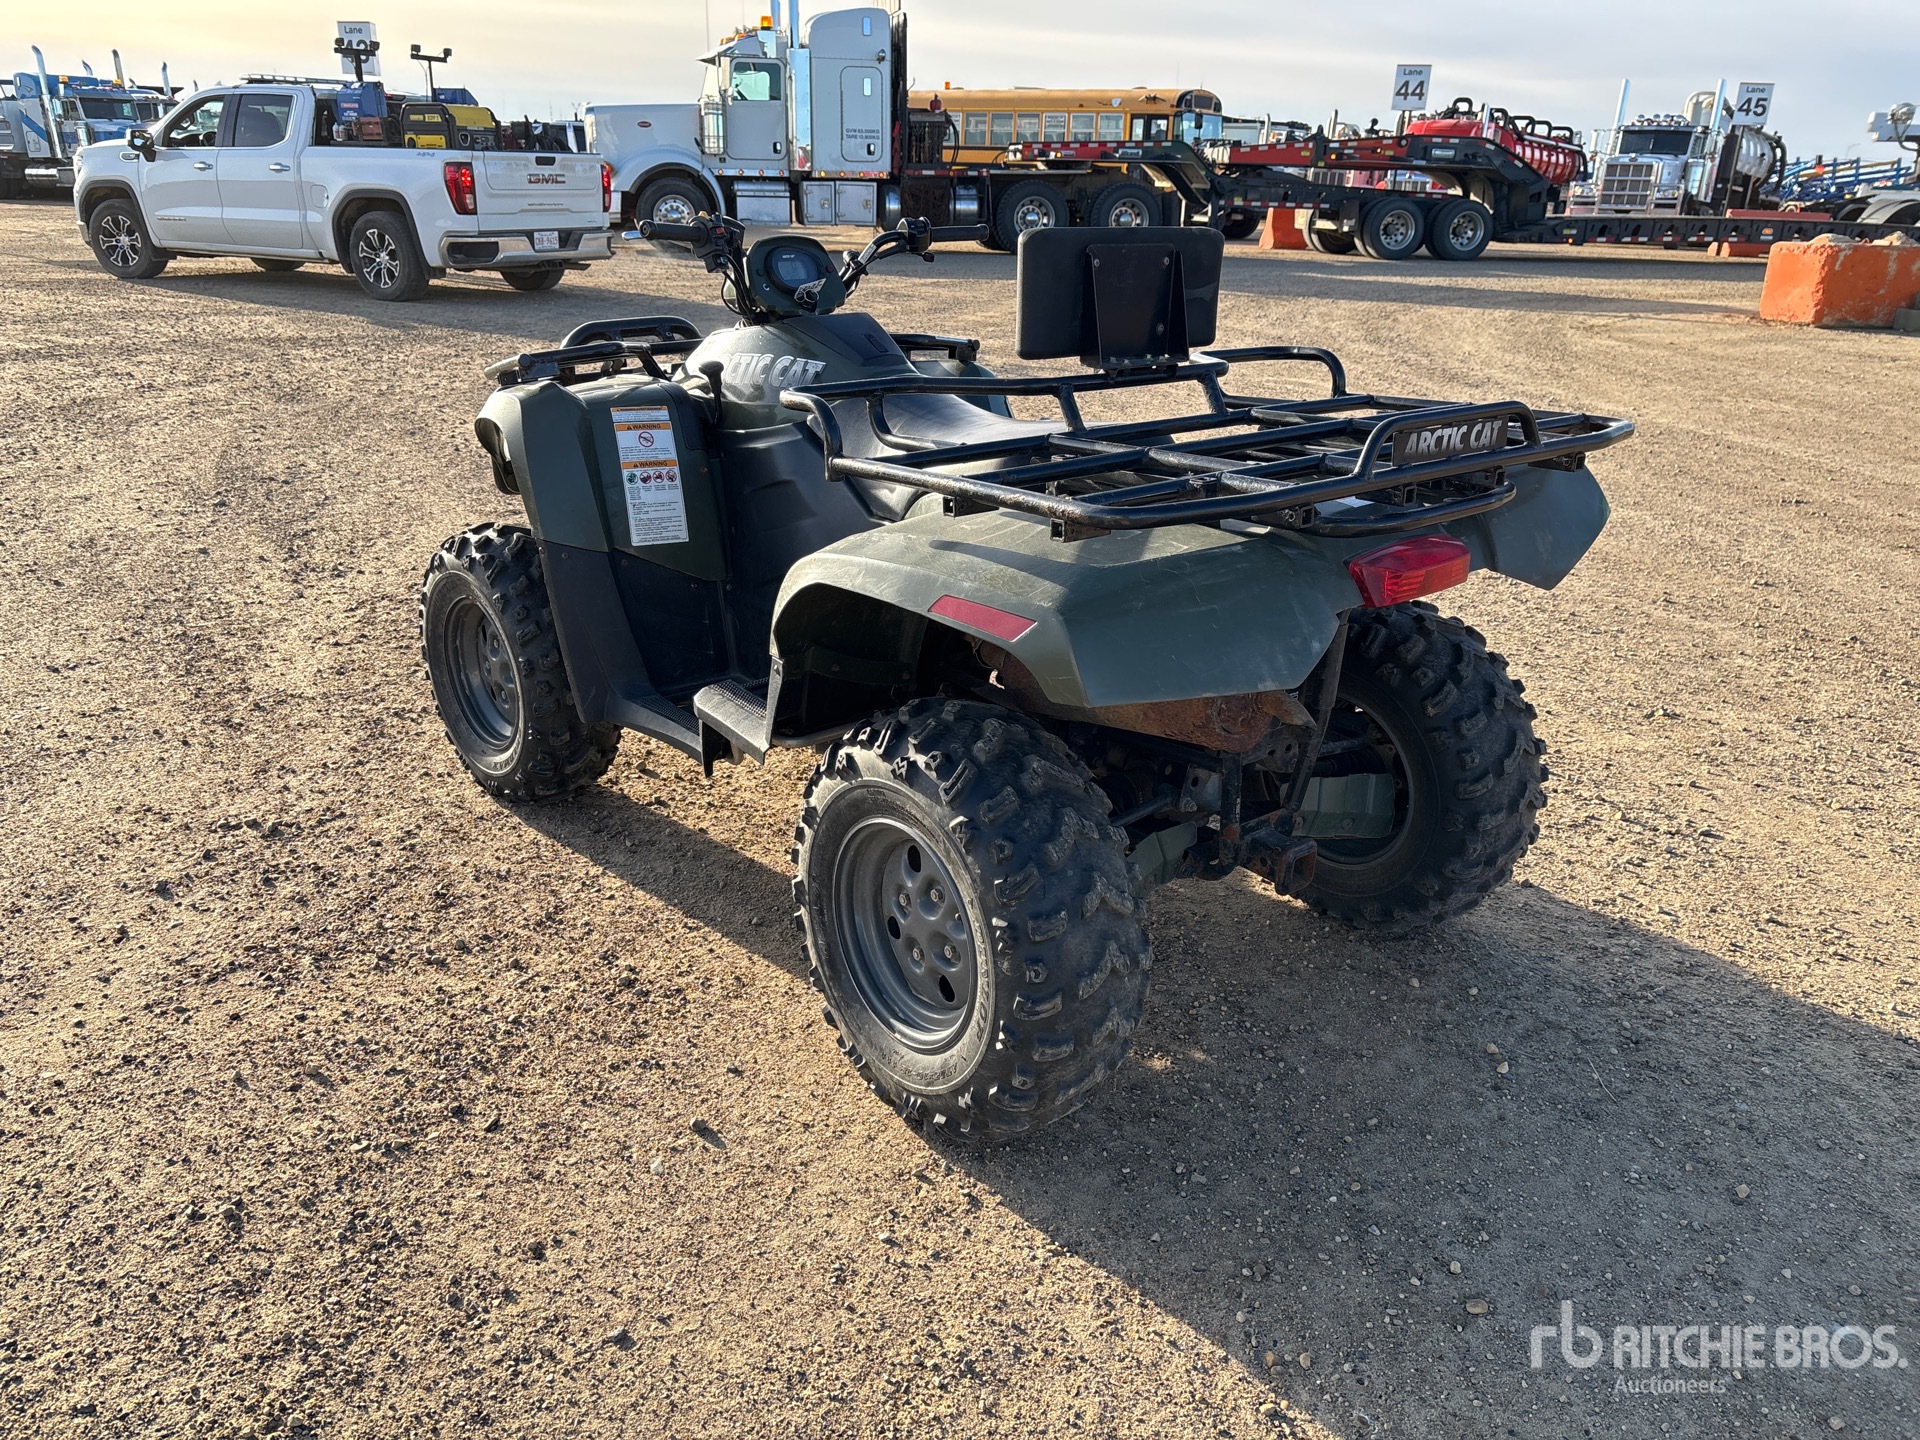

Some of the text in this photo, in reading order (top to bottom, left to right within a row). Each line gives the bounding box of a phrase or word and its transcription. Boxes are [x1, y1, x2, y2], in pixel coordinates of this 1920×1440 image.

[343, 25, 363, 34] Lane
[1403, 68, 1424, 76] Lane
[1395, 80, 1425, 101] 44
[1737, 97, 1768, 117] 45
[527, 173, 566, 184] GMC
[722, 353, 827, 388] CTIC CAT
[1405, 420, 1502, 456] ARCTIC CAT
[639, 460, 668, 468] WARNING
